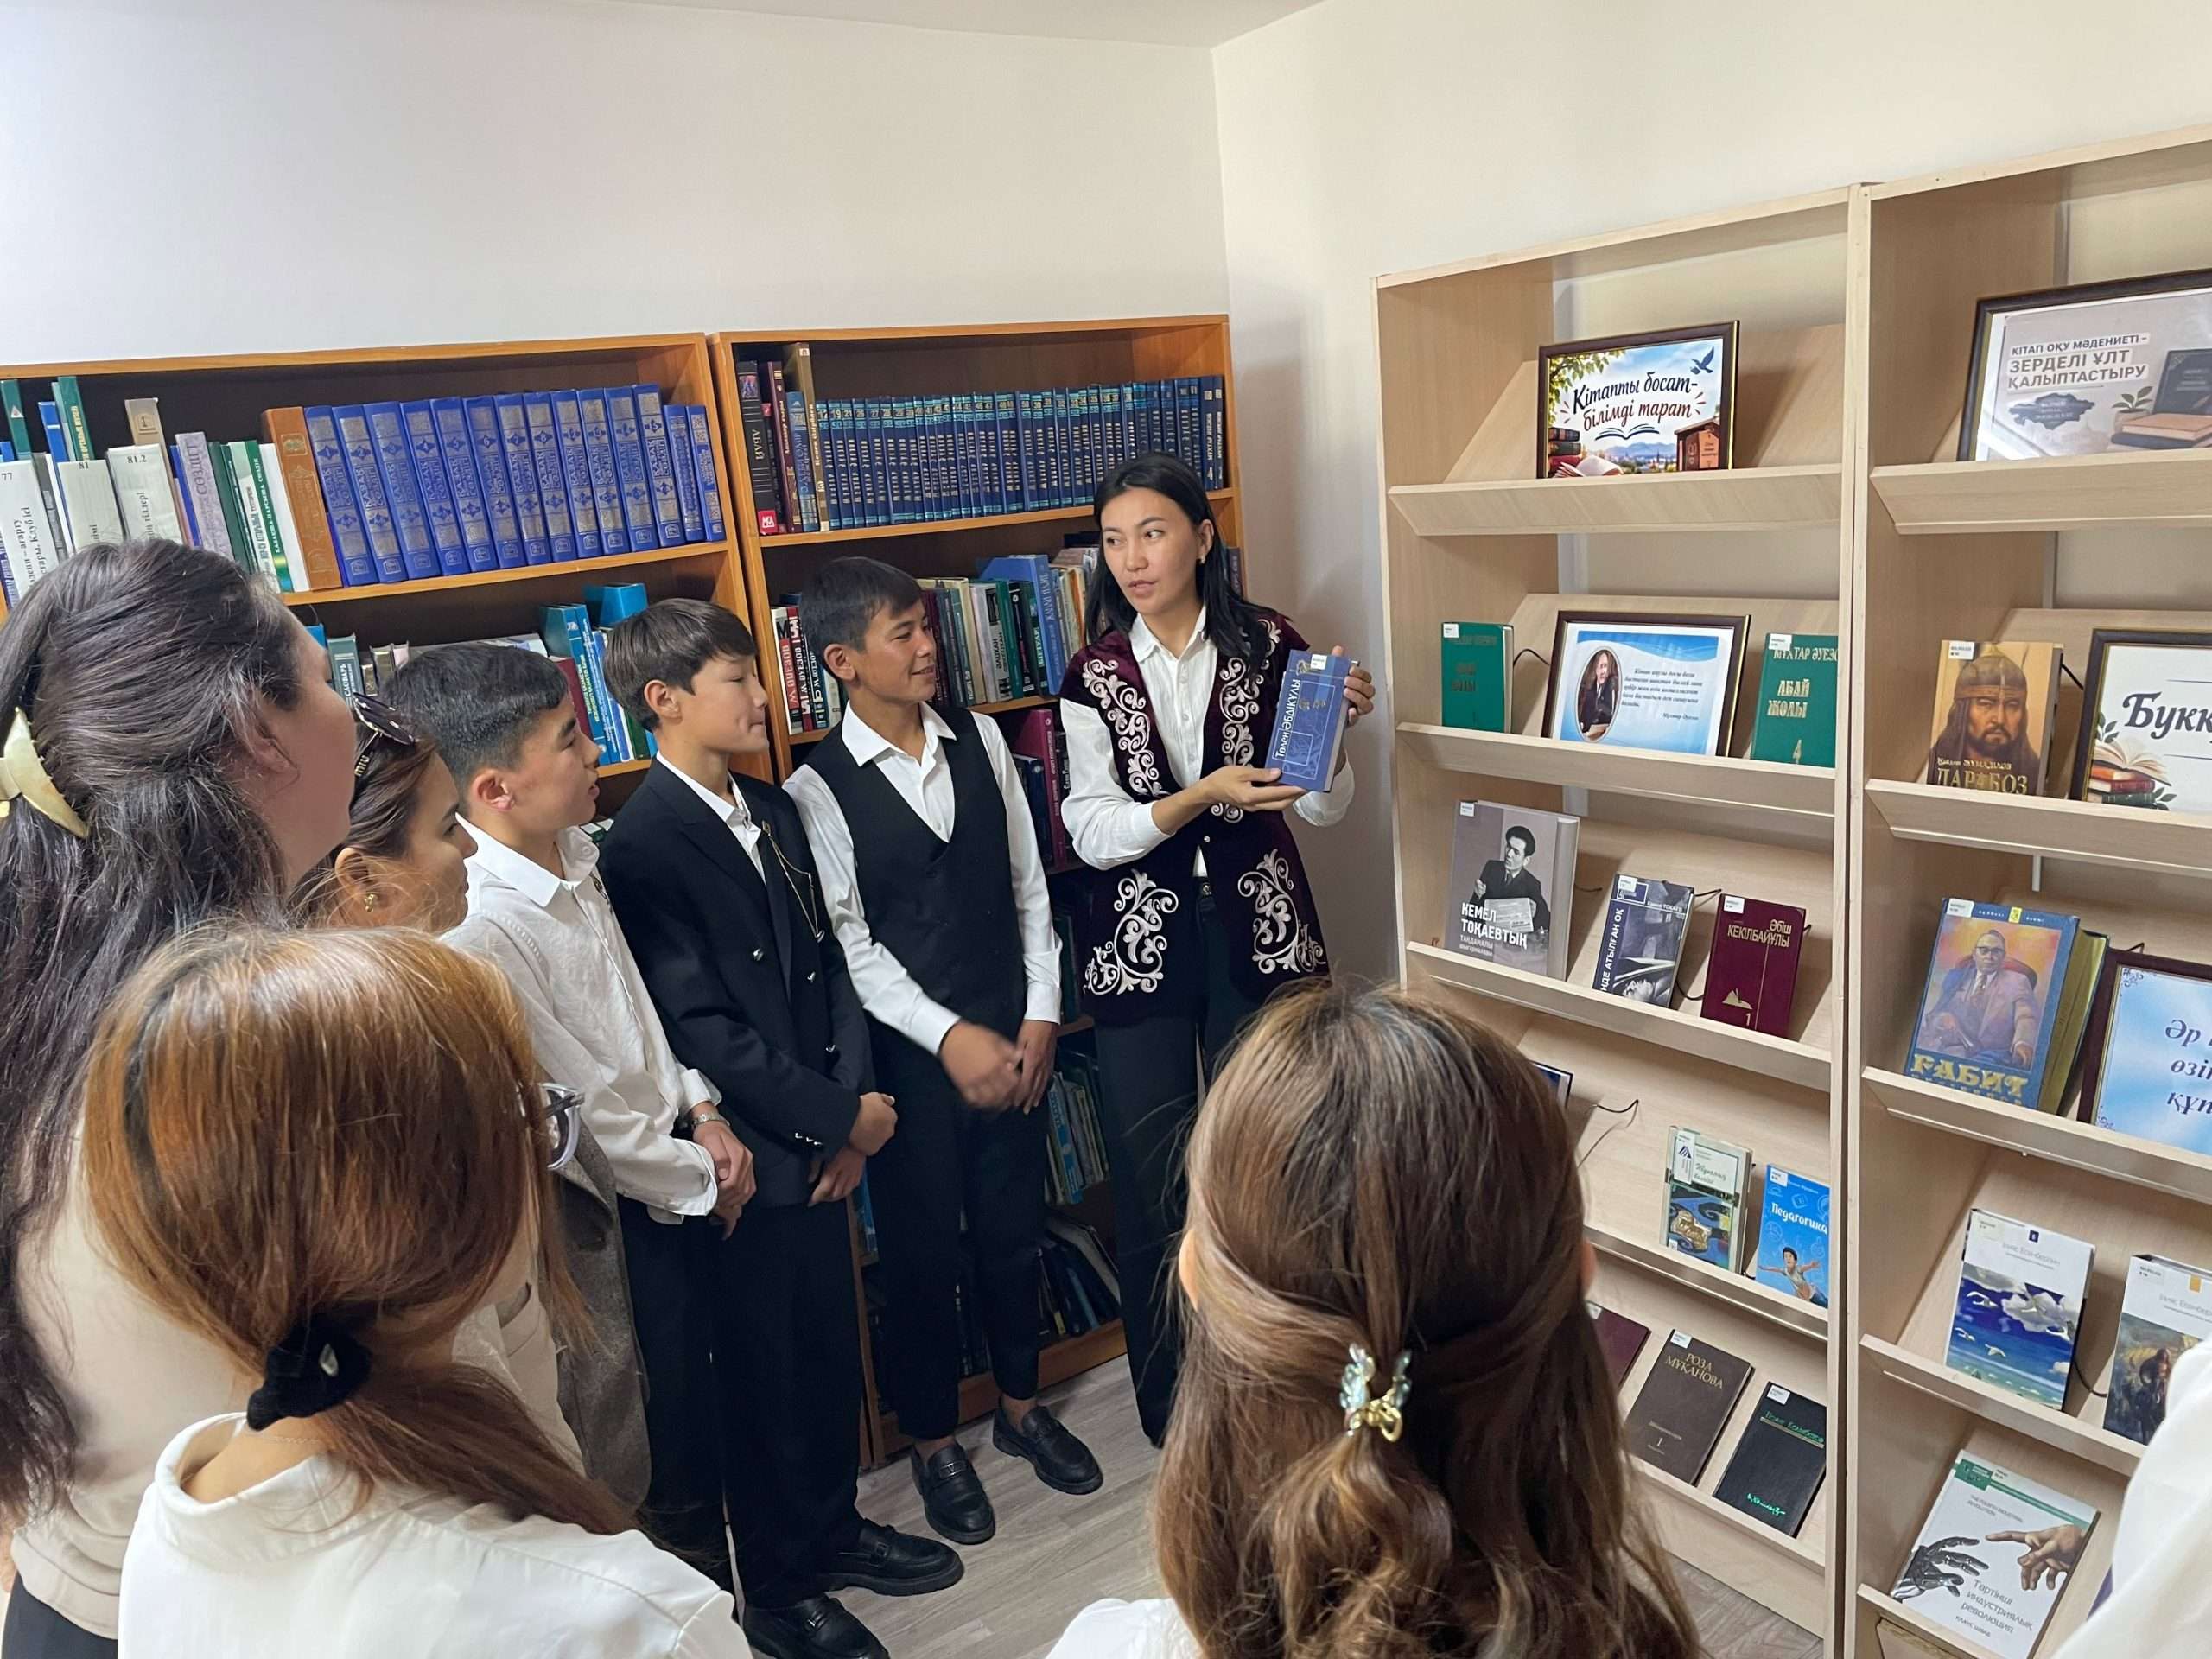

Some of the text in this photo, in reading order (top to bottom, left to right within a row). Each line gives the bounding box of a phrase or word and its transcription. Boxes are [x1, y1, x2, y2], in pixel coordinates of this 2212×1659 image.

[2009, 350, 2130, 373] ЗЕРДЕЛІ ҰЛТ
[2007, 365, 2146, 390] ҚАЛЫПТАСТЫРУ
[1573, 378, 1640, 415] Кітапты
[1583, 399, 1694, 431] білімді тарат
[79, 461, 90, 470] 81
[127, 455, 147, 464] 81.2
[1777, 678, 1810, 697] АБАЙ
[1767, 700, 1808, 718] ЖОЛЫ
[1793, 739, 1802, 764] 4
[1461, 902, 1497, 923] КЕМЕЛ
[1461, 918, 1528, 950] ТОҚАЕВТЫҢ
[1727, 925, 1790, 948] КЕКІЛБАЙҰЛЫ
[1770, 919, 1792, 935] Әбіш
[1606, 925, 1621, 970] АТЫЛҒАН
[1745, 1013, 1751, 1027] 1
[2165, 1019, 2202, 1047] Әр
[1771, 1202, 1828, 1236] Педагогика
[1686, 1352, 1713, 1372] РОЗА
[1656, 1437, 1663, 1447] 1
